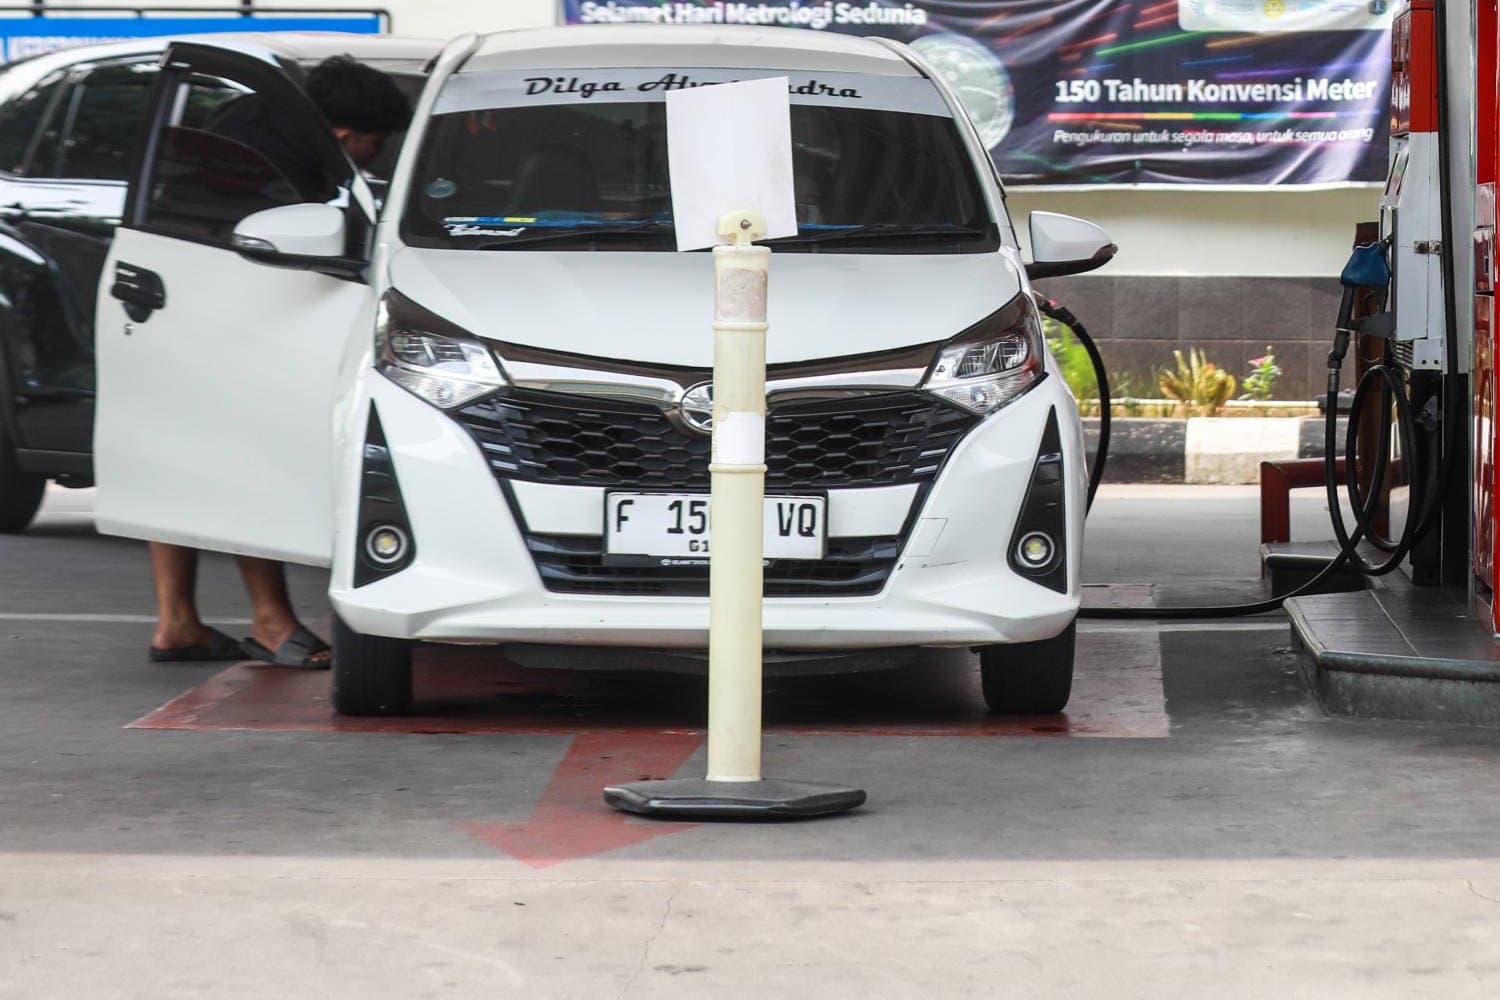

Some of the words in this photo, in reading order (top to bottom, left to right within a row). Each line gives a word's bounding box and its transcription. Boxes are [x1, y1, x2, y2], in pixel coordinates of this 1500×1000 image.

[673, 2, 724, 23] Hari
[725, 2, 833, 29] Metrologi
[834, 1, 927, 25] Sedunia
[523, 76, 624, 98] Dilga
[1055, 79, 1101, 103] 150
[1103, 78, 1183, 102] Tahun
[1187, 78, 1301, 102] Konvensi
[1306, 78, 1378, 101] Meter
[1053, 129, 1131, 145] Pengukuran
[1132, 129, 1169, 143] untuk
[1171, 130, 1214, 146] segala
[1256, 127, 1293, 143] untuk
[1294, 128, 1337, 141] semua
[616, 500, 635, 533] F
[667, 500, 712, 535] 15
[777, 502, 816, 537] VQ
